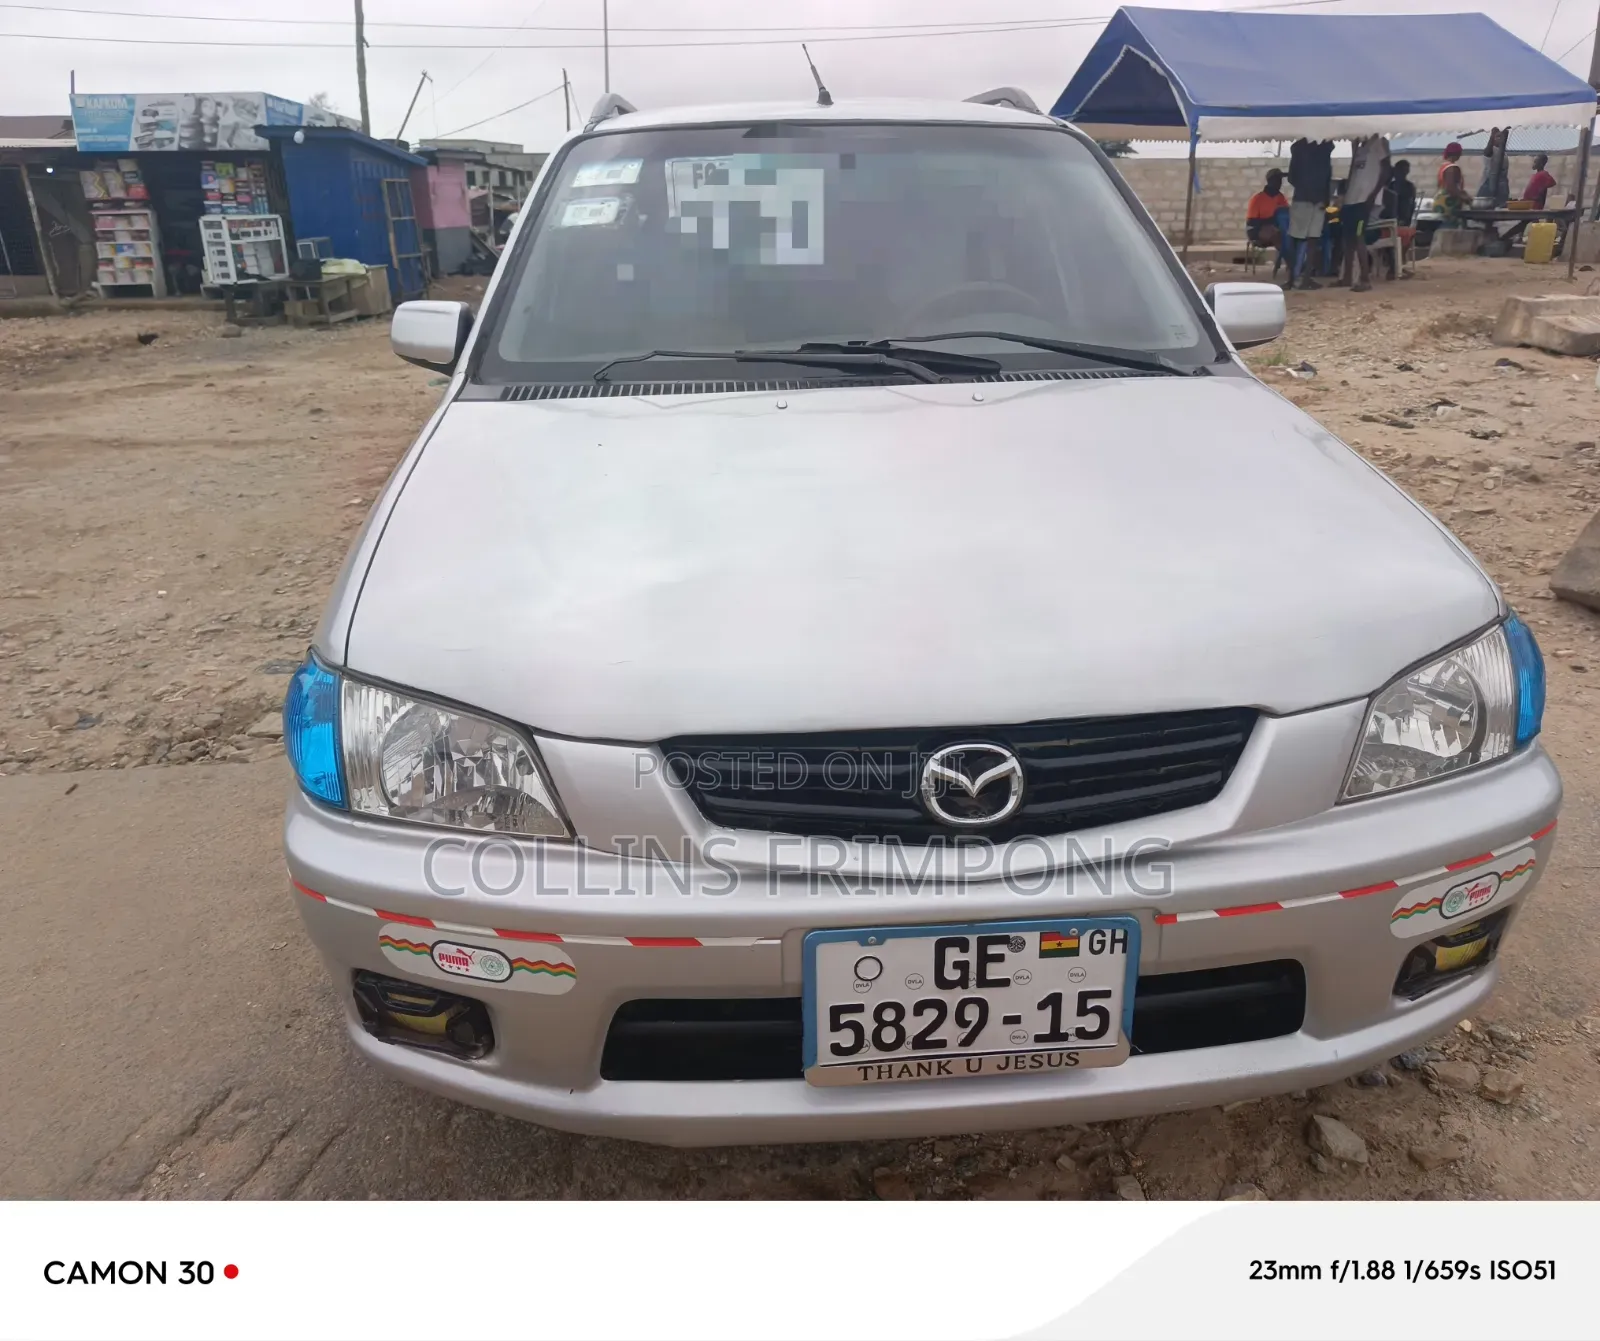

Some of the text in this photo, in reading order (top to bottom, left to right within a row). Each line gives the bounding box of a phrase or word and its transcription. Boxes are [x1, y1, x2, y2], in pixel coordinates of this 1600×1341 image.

[1088, 928, 1128, 955] GH
[438, 952, 469, 967] PUMA
[934, 934, 1011, 990] GE
[857, 1052, 1080, 1081] THANK U JESUS
